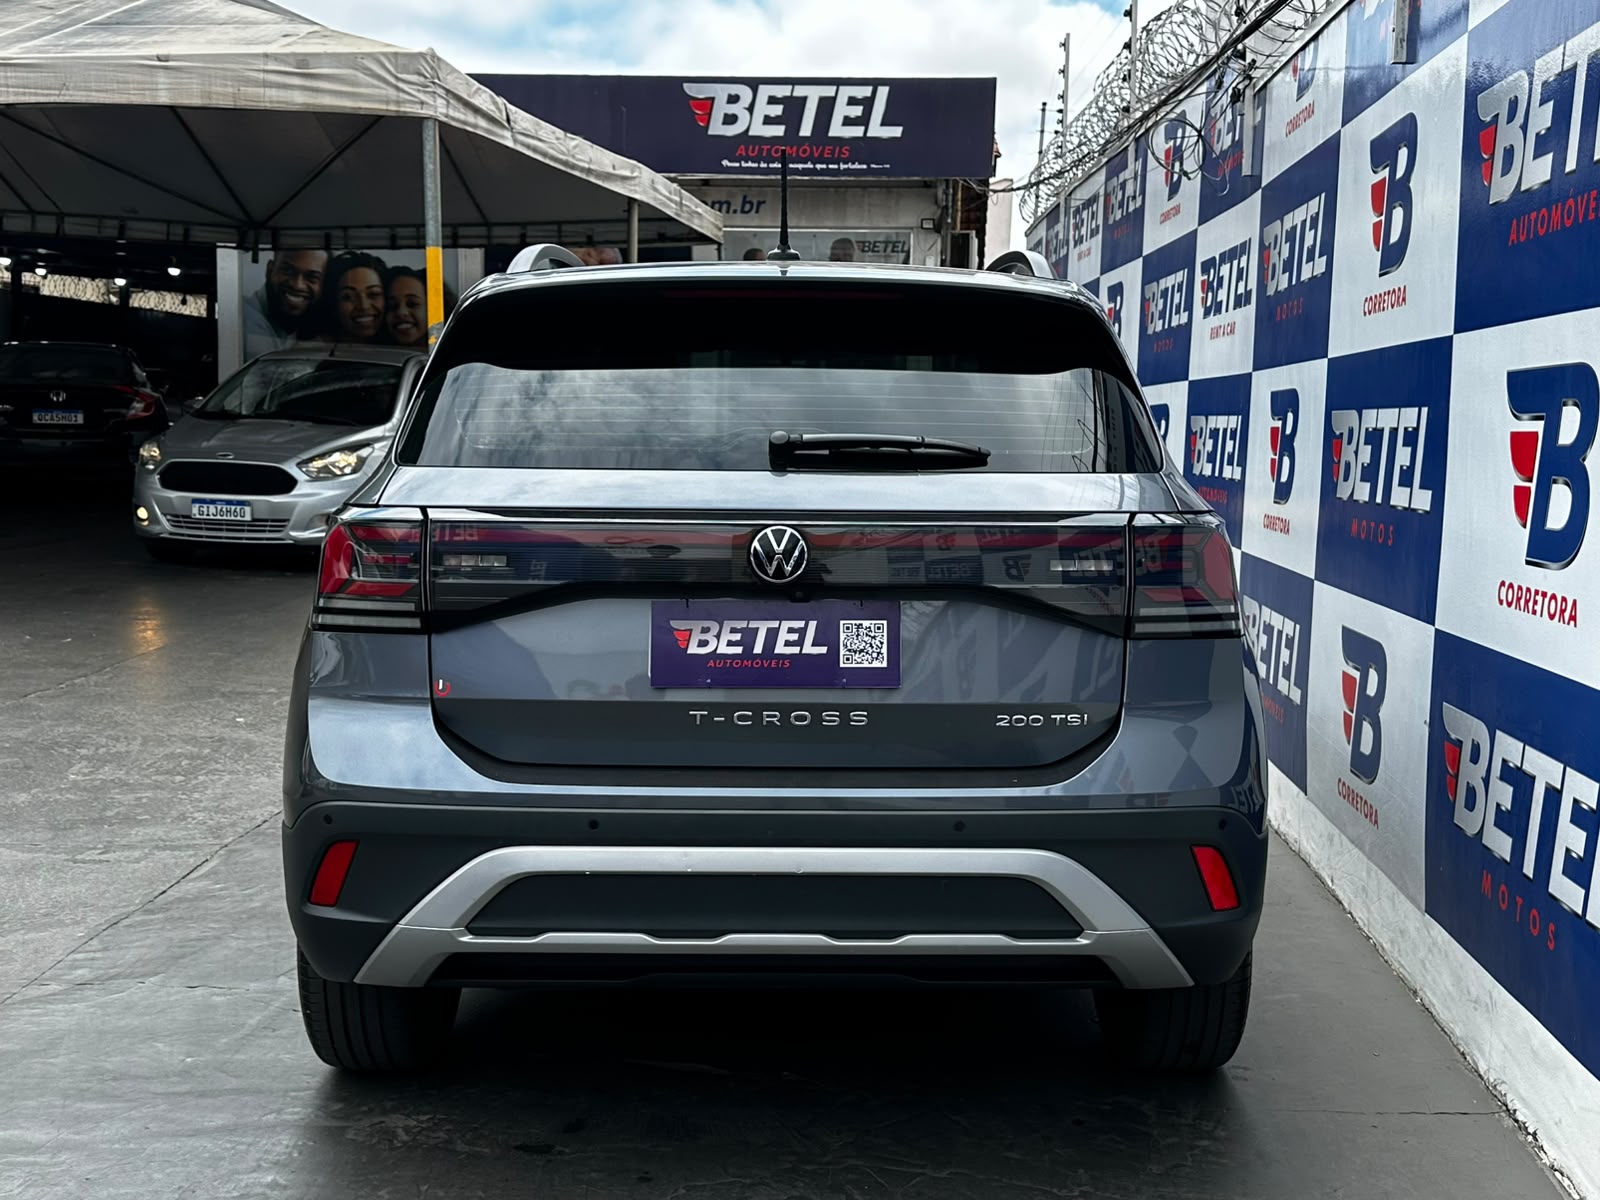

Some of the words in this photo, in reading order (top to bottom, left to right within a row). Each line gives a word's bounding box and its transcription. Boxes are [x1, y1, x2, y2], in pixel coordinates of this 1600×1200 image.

[683, 82, 904, 138] BETEL
[1477, 22, 1600, 205] BET
[735, 144, 850, 158] AUTOMÓVEIS
[701, 195, 766, 214] m.br
[856, 241, 908, 253] BETEL
[1263, 194, 1329, 296] BETEL
[1144, 268, 1189, 335] BETEL
[1200, 237, 1253, 319] BETEL
[1363, 285, 1407, 317] CORRETORA
[1190, 415, 1243, 482] BETEL
[1331, 406, 1433, 514] BETEL
[198, 505, 246, 519] GIJ6H60
[1263, 513, 1290, 535] CORRETORA
[1351, 518, 1394, 546] MOTOS
[751, 525, 808, 583] VW
[1497, 580, 1579, 628] CORRETORA
[669, 620, 828, 655] BETEL
[1242, 594, 1302, 706] BETEL
[688, 711, 869, 726] T-CROSS
[996, 714, 1044, 727] 200
[1050, 713, 1088, 727] TSI
[1338, 777, 1380, 830] CORRETORA
[1482, 870, 1556, 952] MOTOS
